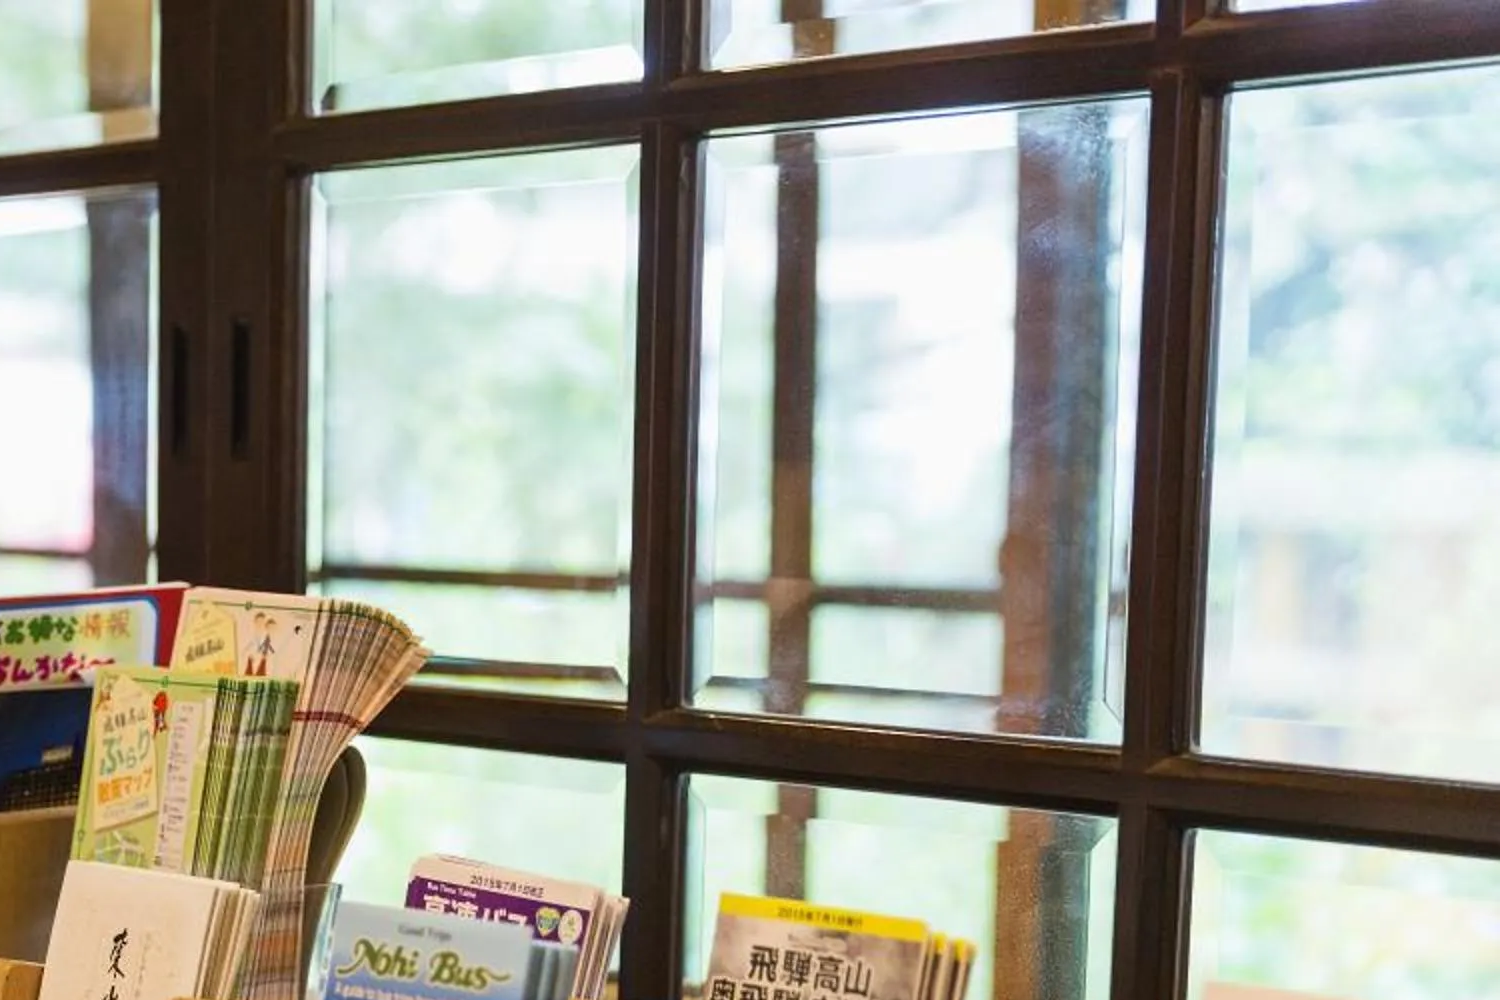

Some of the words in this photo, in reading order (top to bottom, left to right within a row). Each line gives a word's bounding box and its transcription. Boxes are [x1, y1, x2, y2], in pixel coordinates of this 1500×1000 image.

[336, 937, 420, 979] Nohi
[429, 949, 511, 990] Bus
[749, 944, 872, 997] 飛騨高山
